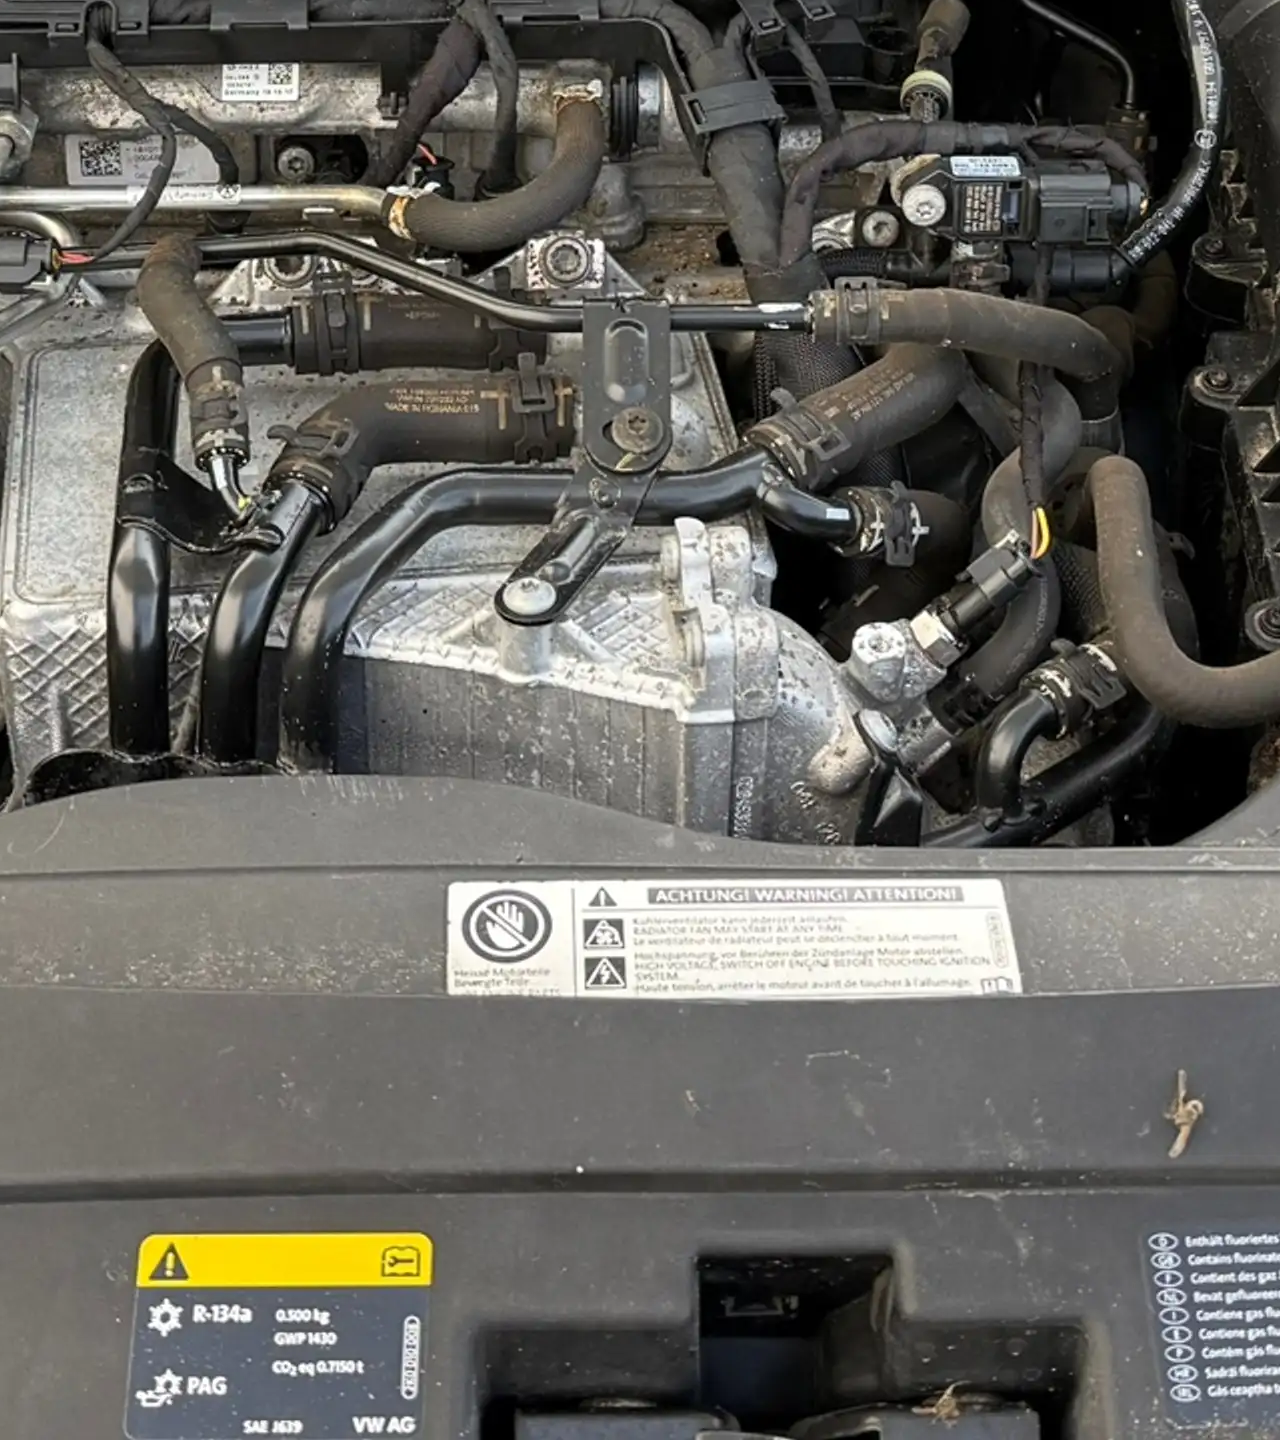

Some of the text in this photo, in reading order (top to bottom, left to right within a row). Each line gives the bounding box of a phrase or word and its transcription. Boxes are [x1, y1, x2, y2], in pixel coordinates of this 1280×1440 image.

[656, 888, 957, 902] ACHTUNG! WARNING! ATTENTION!
[634, 926, 686, 935] RADIATOR
[689, 926, 711, 935] FAN
[715, 926, 738, 934] MAY
[743, 925, 772, 934] START
[776, 925, 789, 933] AT
[793, 925, 814, 933] ANY
[634, 937, 645, 946] Le
[648, 936, 706, 945] ventilateur
[710, 936, 722, 945] de
[725, 936, 773, 945] radiateur
[877, 948, 911, 957] Motor
[634, 962, 664, 970] HIGH
[720, 961, 763, 969] SWITCH
[766, 960, 786, 969] OFF
[789, 959, 828, 969] ENGINE
[834, 958, 874, 967] BEFORE
[877, 958, 937, 966] TOUCHING
[940, 957, 990, 966] IGNITION
[1224, 1233, 1280, 1246] fluoriertes
[1188, 1254, 1232, 1266] Contains
[1190, 1272, 1236, 1285] Contient
[1238, 1271, 1256, 1282] des
[1193, 1291, 1223, 1303] Bevat
[192, 1303, 253, 1324] R-134a
[313, 1308, 331, 1325] kg
[1196, 1309, 1243, 1321] Contiene
[1245, 1309, 1264, 1322] gas
[274, 1332, 338, 1345] GWP 1430
[1198, 1328, 1245, 1340] Contiene
[1247, 1328, 1266, 1341] gas
[298, 1361, 316, 1376] eq
[316, 1360, 356, 1374] 0.7150
[356, 1360, 365, 1374] t
[187, 1377, 227, 1395] PAG
[243, 1419, 270, 1433] SAE
[352, 1416, 385, 1433] VW
[386, 1416, 417, 1434] AG
